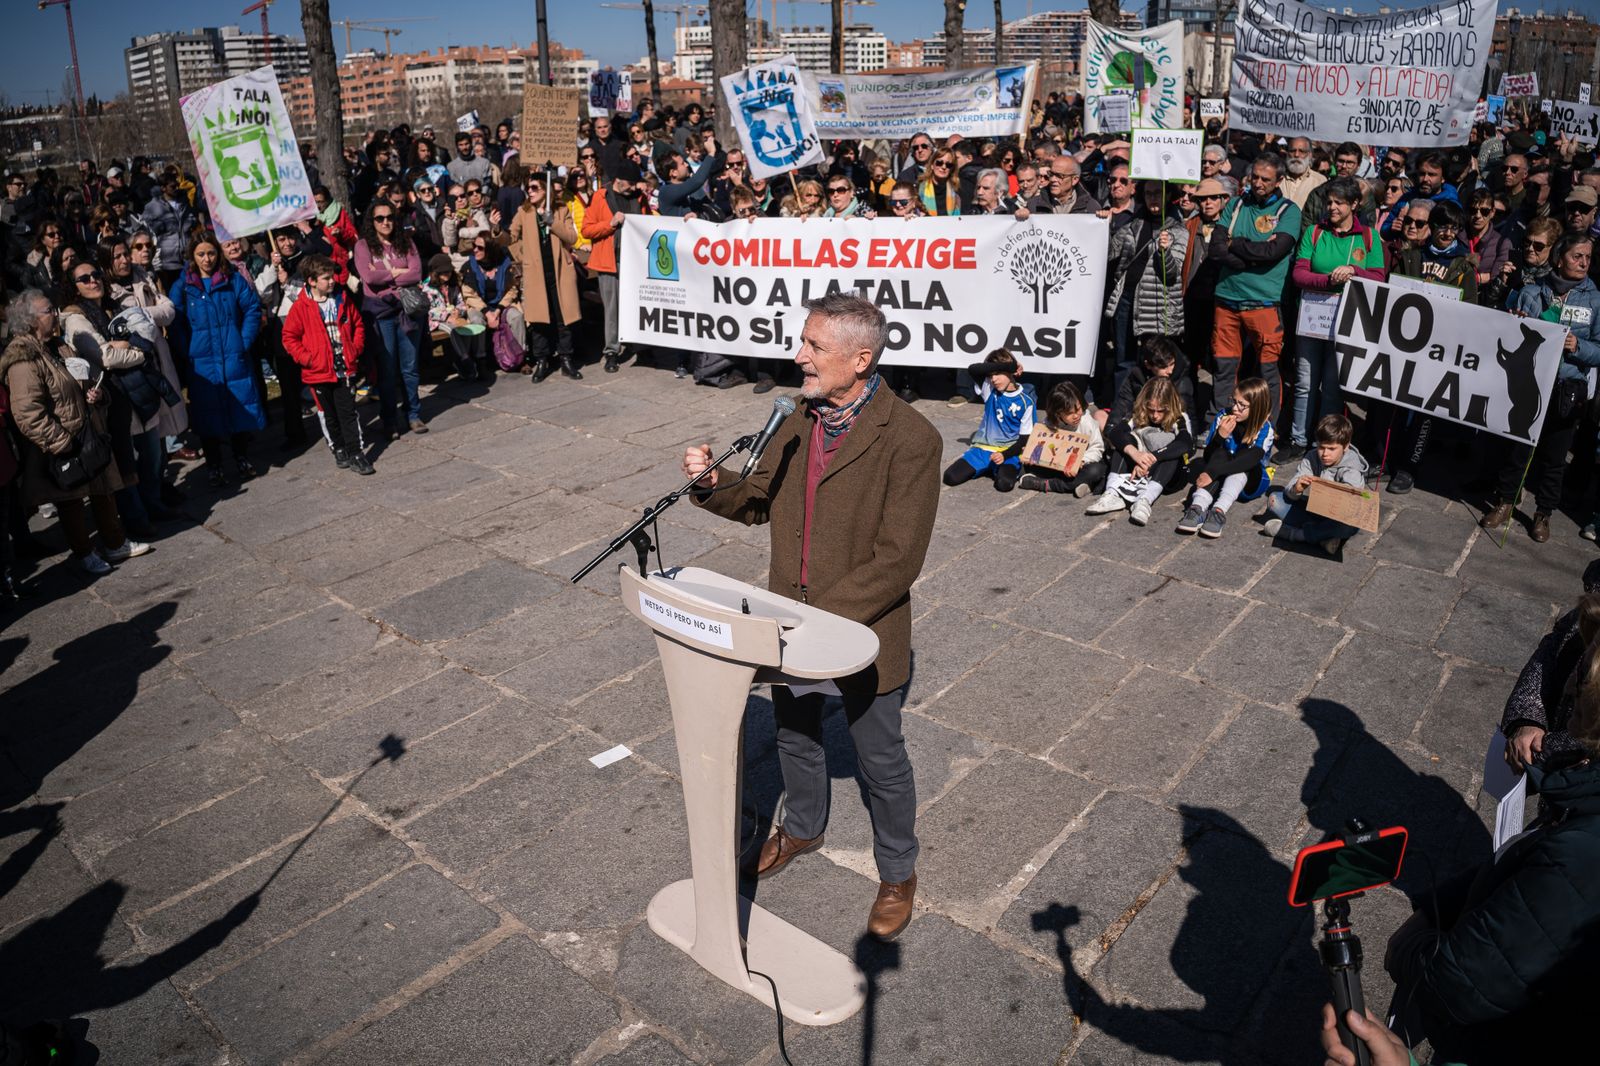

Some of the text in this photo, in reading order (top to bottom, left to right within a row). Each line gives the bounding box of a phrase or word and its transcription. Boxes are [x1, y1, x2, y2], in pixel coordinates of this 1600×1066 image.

[1272, 2, 1285, 25] A
[1293, 7, 1314, 33] LA
[1457, 0, 1476, 28] DE
[1140, 35, 1172, 66] este
[1239, 26, 1306, 61] NUESTROS
[1317, 33, 1385, 64] PARQUES
[1400, 30, 1477, 68] BARRIOS
[757, 70, 798, 86] TALA
[917, 82, 933, 90] SE
[1295, 64, 1350, 96] AYUSO
[234, 88, 272, 104] TALA
[1581, 86, 1590, 94] NO
[235, 109, 271, 126] ¡NO!
[1359, 97, 1446, 120] SINDICATO DE
[1554, 106, 1575, 122] NO
[881, 119, 919, 127] VECINOS
[921, 115, 955, 124] PASILLO
[1347, 115, 1444, 136] ESTUDIANTES
[1553, 121, 1580, 136] TALA
[1137, 136, 1154, 144] ¡NO
[1163, 136, 1174, 144] LA
[1175, 137, 1199, 145] TALA!
[997, 223, 1043, 258] defiendo
[1046, 229, 1070, 247] este
[692, 236, 978, 270] COMILLAS EXIGE
[993, 259, 1006, 275] Yo
[713, 275, 758, 306] NO
[766, 277, 792, 307] A
[852, 279, 953, 311] TALA
[638, 306, 740, 342] METRO
[749, 311, 793, 351] SÍ,
[923, 323, 989, 354] NO
[1002, 319, 1082, 359] ASÍ
[1337, 279, 1435, 354] NO
[1428, 343, 1445, 362] a
[1454, 344, 1480, 372] la
[1335, 341, 1461, 420] TALA
[674, 612, 692, 625] PERO
[693, 619, 706, 630] NO
[708, 624, 722, 635] ASÍ
